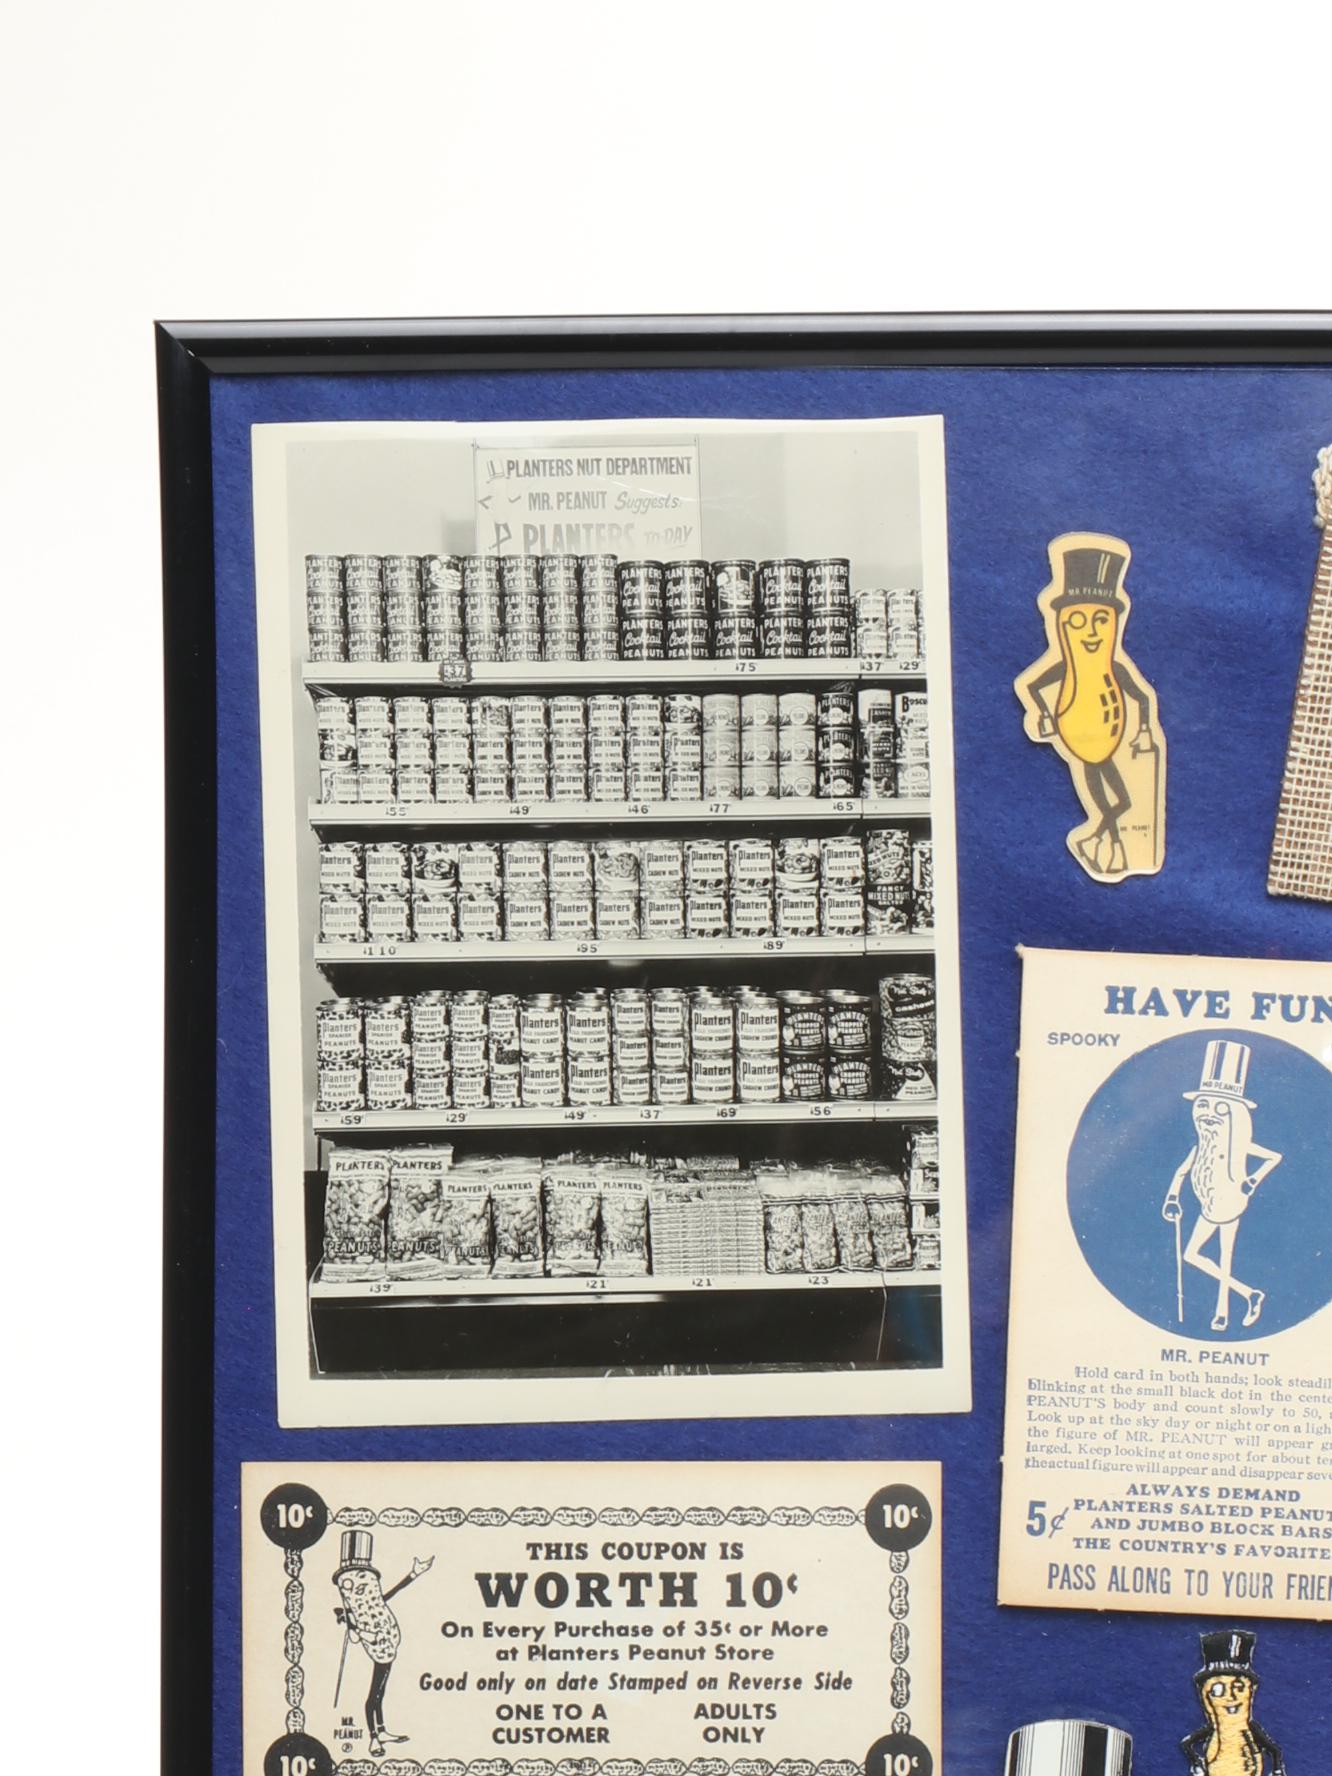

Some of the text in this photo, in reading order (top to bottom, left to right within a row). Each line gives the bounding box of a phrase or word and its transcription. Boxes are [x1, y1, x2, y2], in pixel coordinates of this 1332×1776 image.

[506, 456, 693, 478] PLANTERS NUT DEPARTMENT
[528, 492, 553, 511] MR.
[557, 491, 607, 510] PEANUT
[714, 617, 757, 630] PLANTERS
[715, 629, 754, 647] Cocktail
[715, 647, 757, 658] PEANUTS
[692, 850, 724, 862] Planters
[1104, 985, 1230, 1020] HAVE
[522, 1016, 560, 1030] Planters
[1047, 1031, 1120, 1047] SPOOKY
[1161, 1348, 1270, 1366] MR. PEANUT
[1074, 1366, 1109, 1379] Hold
[1113, 1368, 1144, 1381] card
[1149, 1369, 1164, 1382] in
[1168, 1369, 1200, 1383] both
[1204, 1371, 1249, 1387] hands;
[1253, 1373, 1283, 1387] look
[1126, 1483, 1301, 1502] ALWAYS DEMAND
[276, 1503, 313, 1529] 10¢
[882, 1503, 919, 1529] 10¢
[1074, 1498, 1173, 1514] PLANTERS
[1179, 1503, 1254, 1518] SALTED
[1026, 1501, 1069, 1539] 5¢
[1090, 1517, 1332, 1539] AND JUMBO BLOCK BARS
[526, 1542, 744, 1560] THIS COUPON IS
[1072, 1537, 1111, 1550] THE
[1119, 1539, 1227, 1556] COUNTRY'S
[1047, 1562, 1096, 1591] PASS
[1107, 1565, 1171, 1595] ALONG
[1184, 1568, 1209, 1597] TO
[1222, 1571, 1274, 1599] YOUR
[474, 1572, 798, 1609] WORTH 10¢
[441, 1620, 828, 1641] On Every Purchase of 35¢ or More
[496, 1643, 774, 1661] at Planters Peanut Store
[496, 1704, 608, 1721] ONE TO A
[693, 1703, 777, 1720] ADULTS
[492, 1727, 610, 1744] CUSTOMER
[703, 1726, 765, 1744] ONLY
